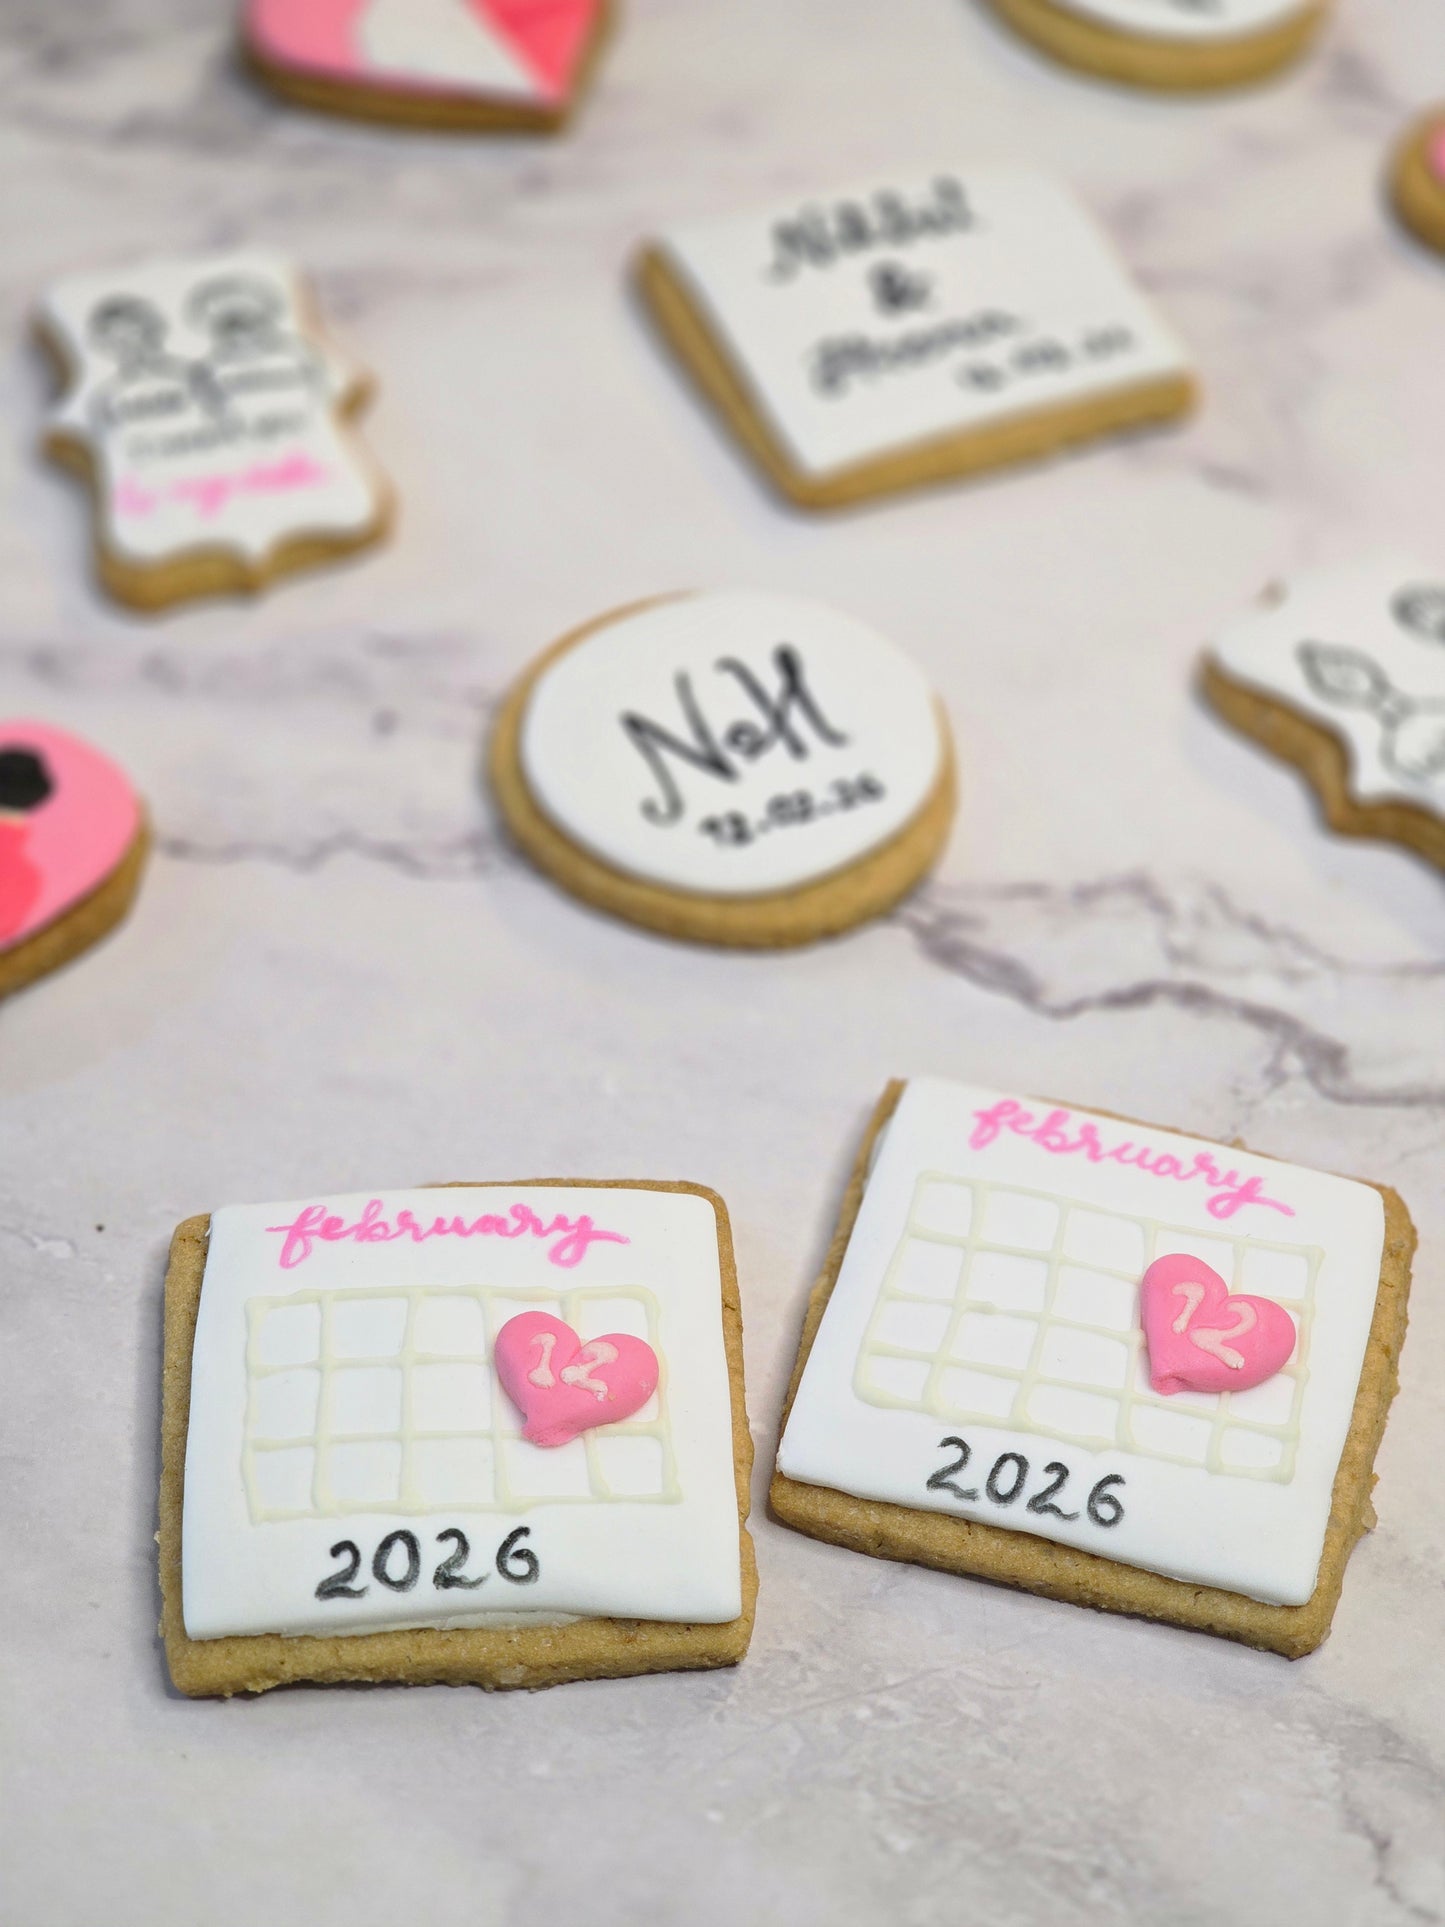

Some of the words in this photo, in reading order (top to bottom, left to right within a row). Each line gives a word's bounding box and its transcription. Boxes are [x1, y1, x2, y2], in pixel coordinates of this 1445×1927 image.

[969, 1099, 1295, 1219] february
[265, 1198, 631, 1270] february
[1171, 1281, 1257, 1369] 12
[527, 1332, 619, 1402] 12
[926, 1436, 1126, 1528] 2026
[314, 1526, 540, 1601] 2026
